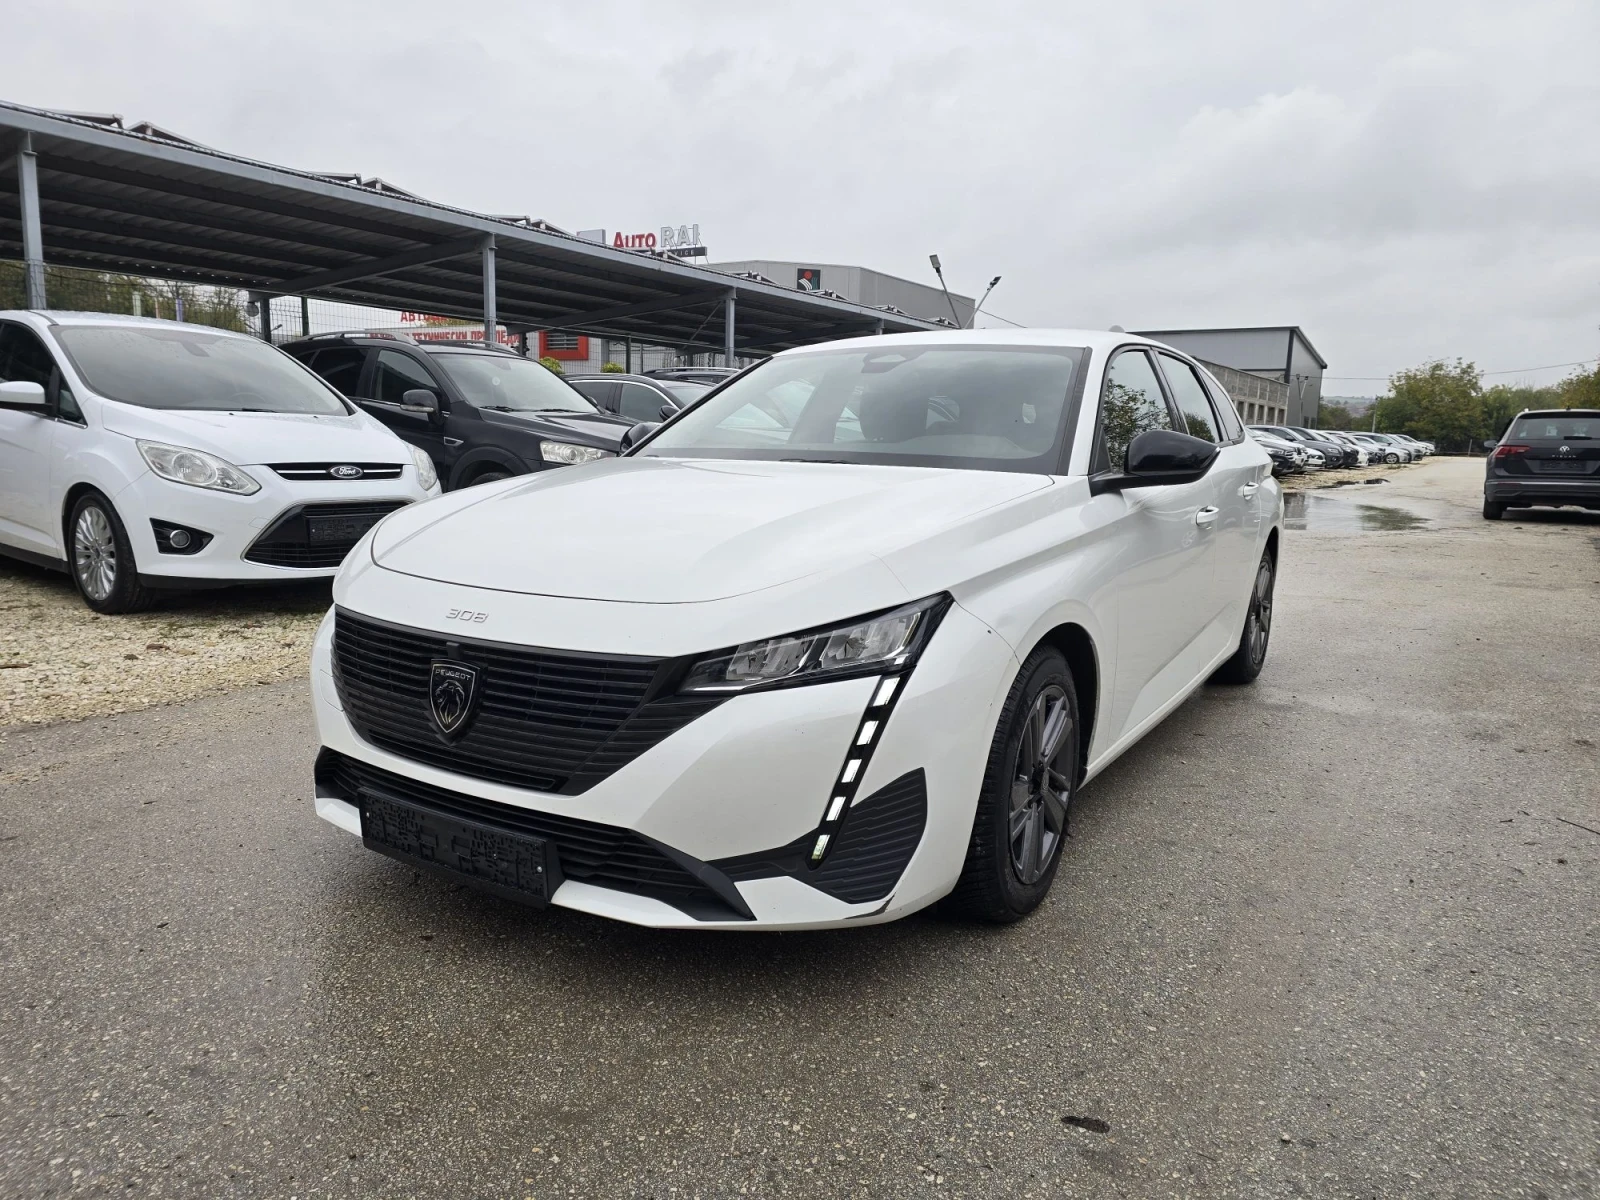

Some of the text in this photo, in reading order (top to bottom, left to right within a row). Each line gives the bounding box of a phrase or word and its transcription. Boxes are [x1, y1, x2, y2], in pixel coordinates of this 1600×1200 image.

[338, 465, 357, 475] Ford
[445, 608, 489, 624] 308
[435, 669, 471, 681] PEUGEOT
